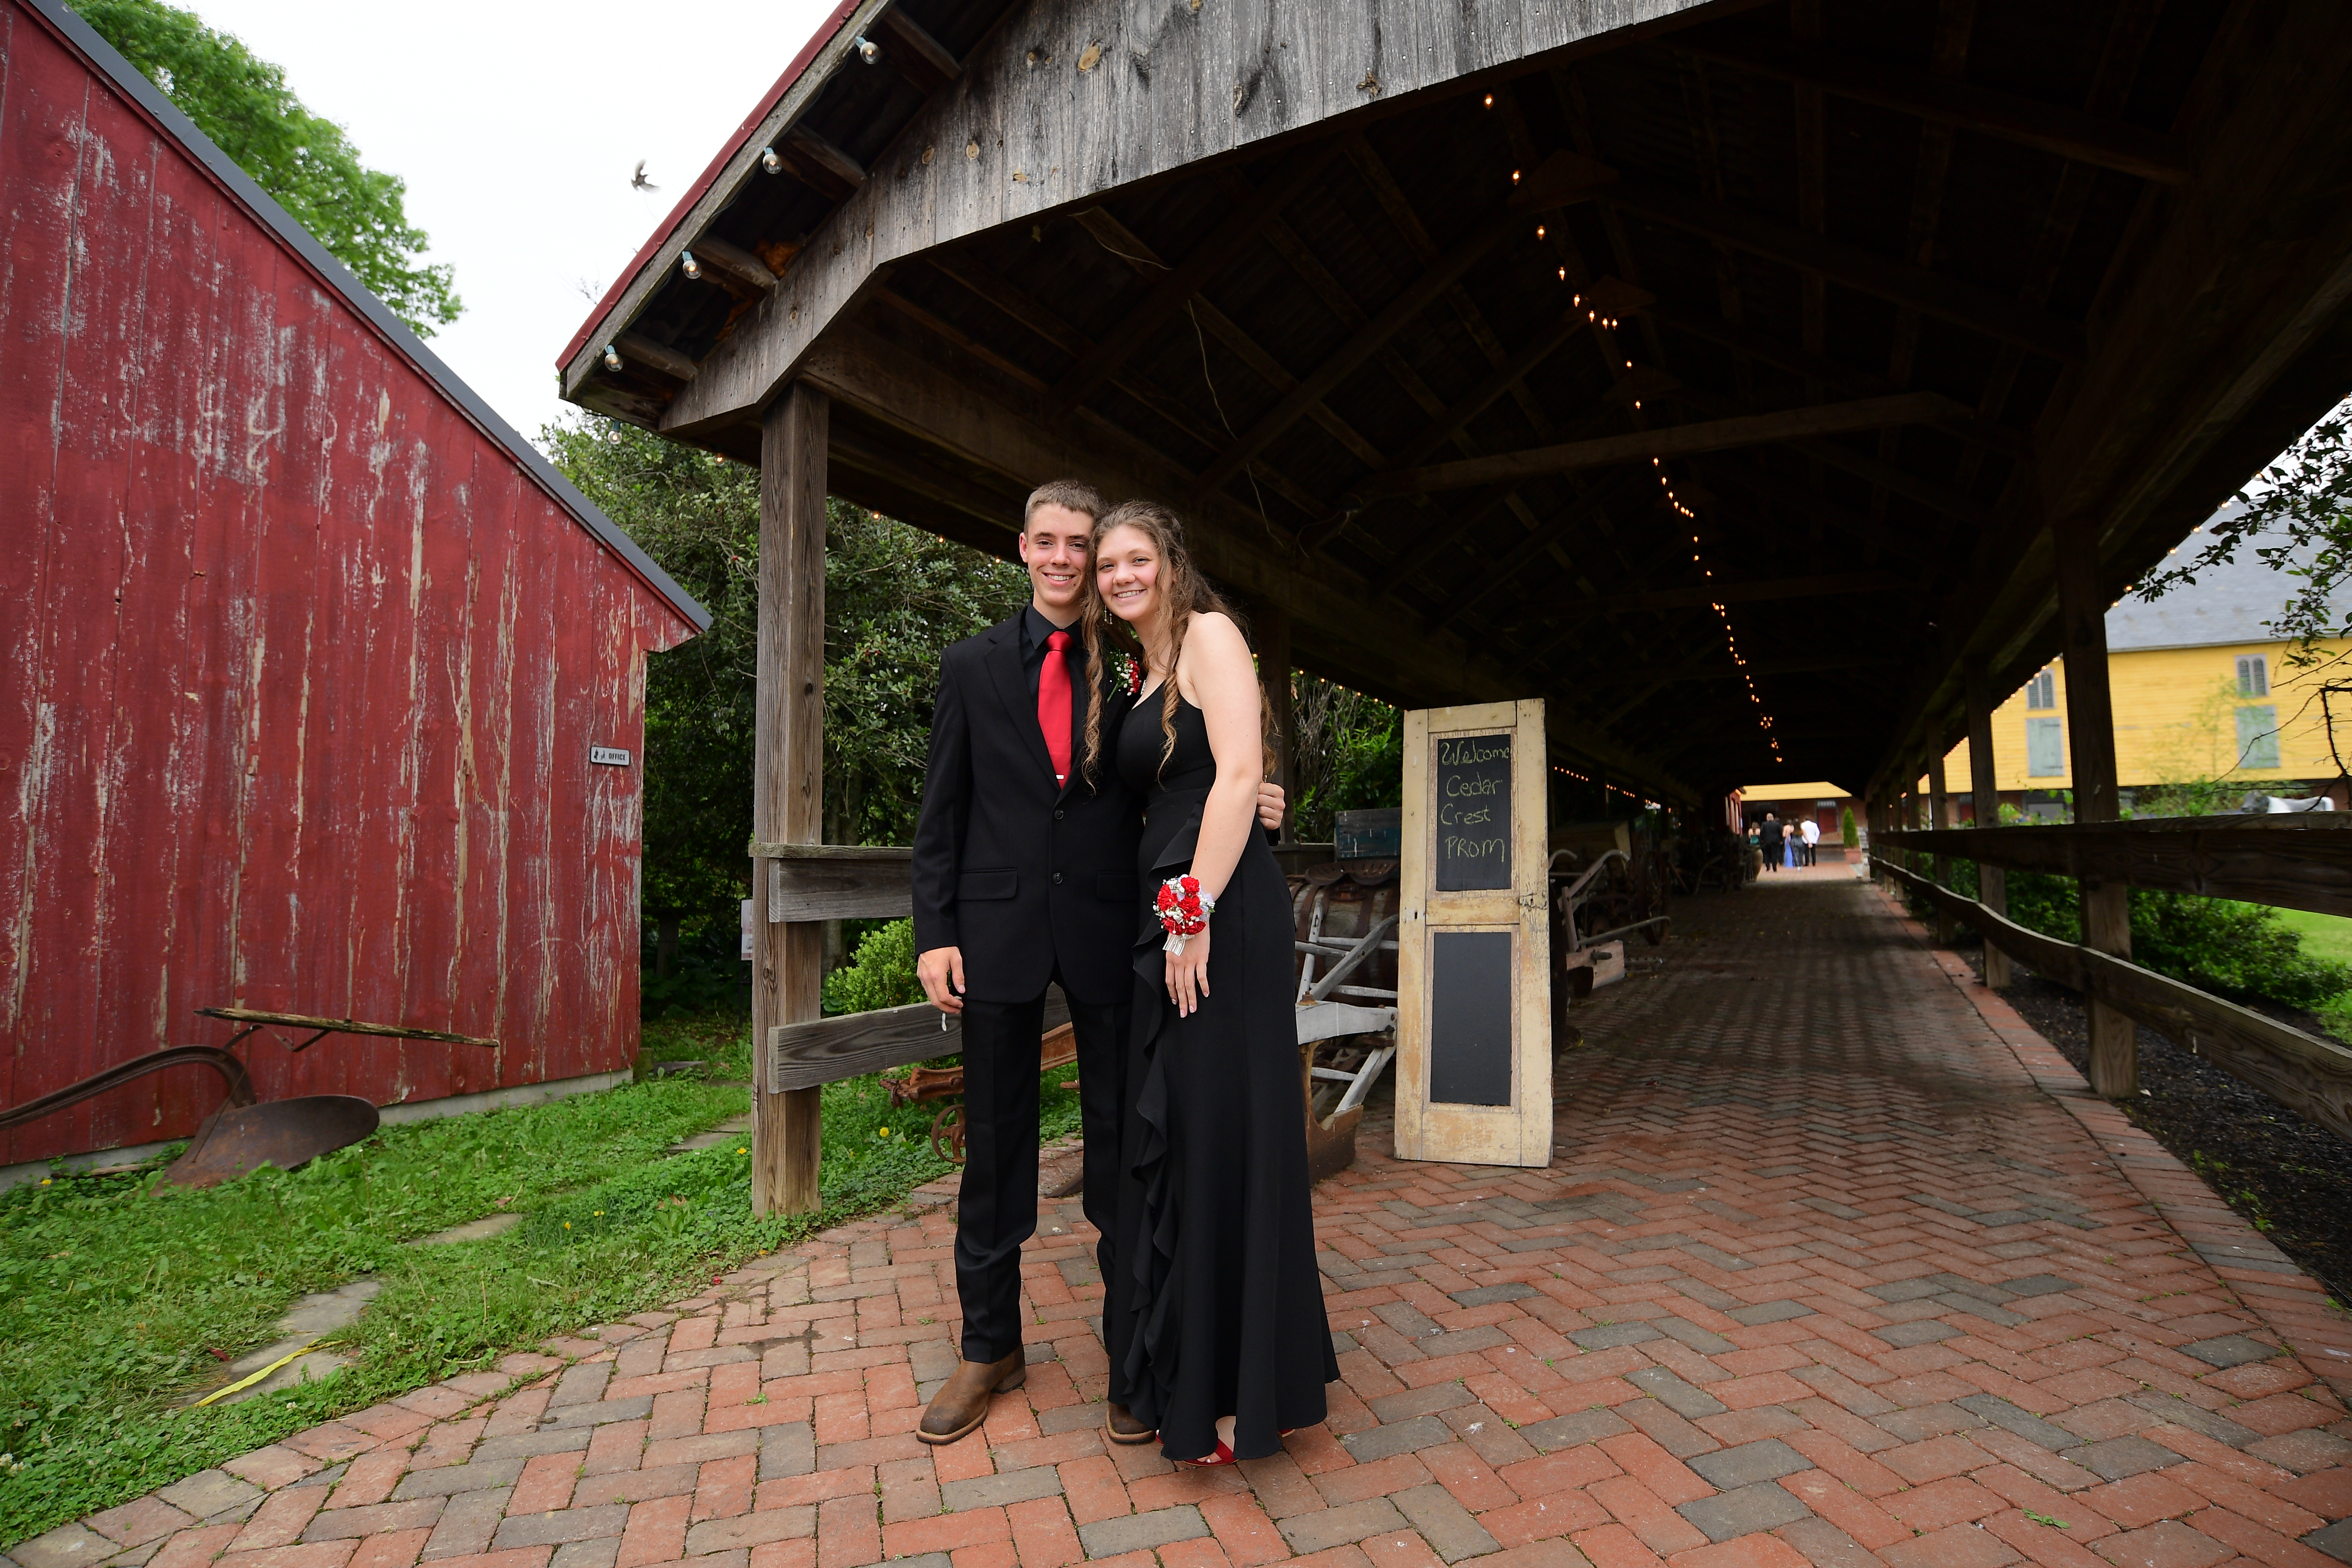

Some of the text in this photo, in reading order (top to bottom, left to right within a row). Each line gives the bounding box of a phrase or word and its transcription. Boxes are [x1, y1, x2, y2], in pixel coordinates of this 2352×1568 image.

[608, 753, 625, 761] OFFICE
[1440, 740, 1509, 765] Welcome
[1446, 771, 1503, 797] Cedar
[1440, 803, 1491, 825] Crest
